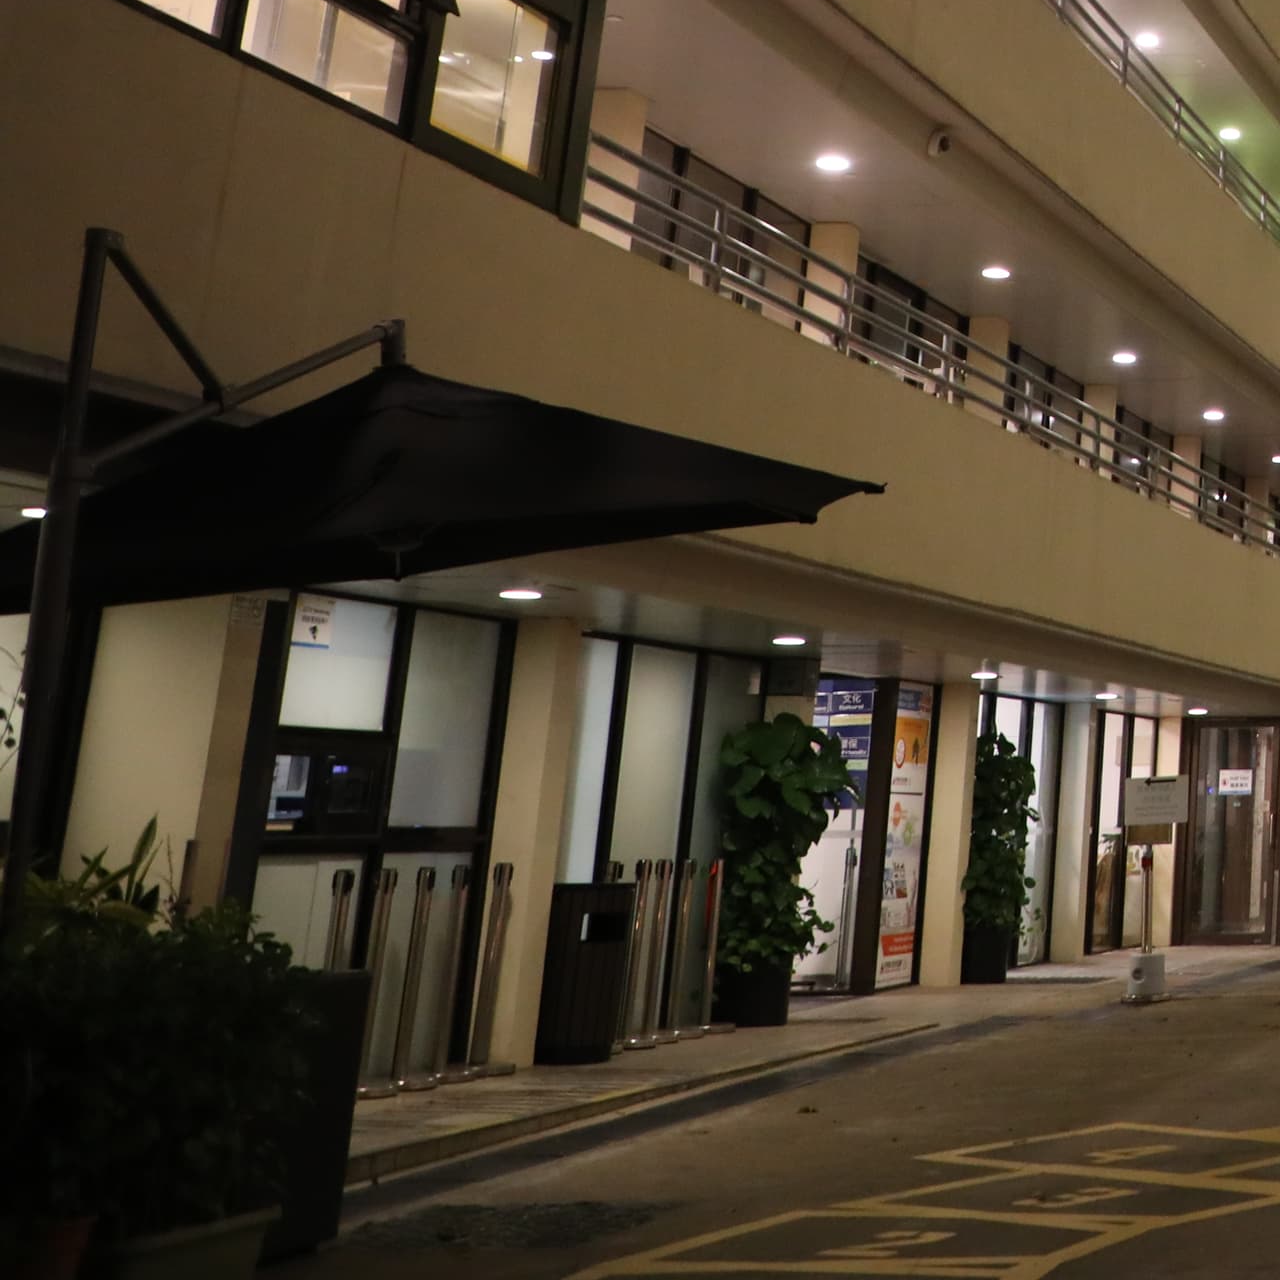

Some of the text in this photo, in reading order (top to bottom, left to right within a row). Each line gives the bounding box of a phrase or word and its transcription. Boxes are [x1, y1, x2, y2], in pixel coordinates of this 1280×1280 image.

[1083, 1144, 1178, 1163] 4
[1010, 1186, 1139, 1209] 3
[814, 1230, 958, 1257] 2
